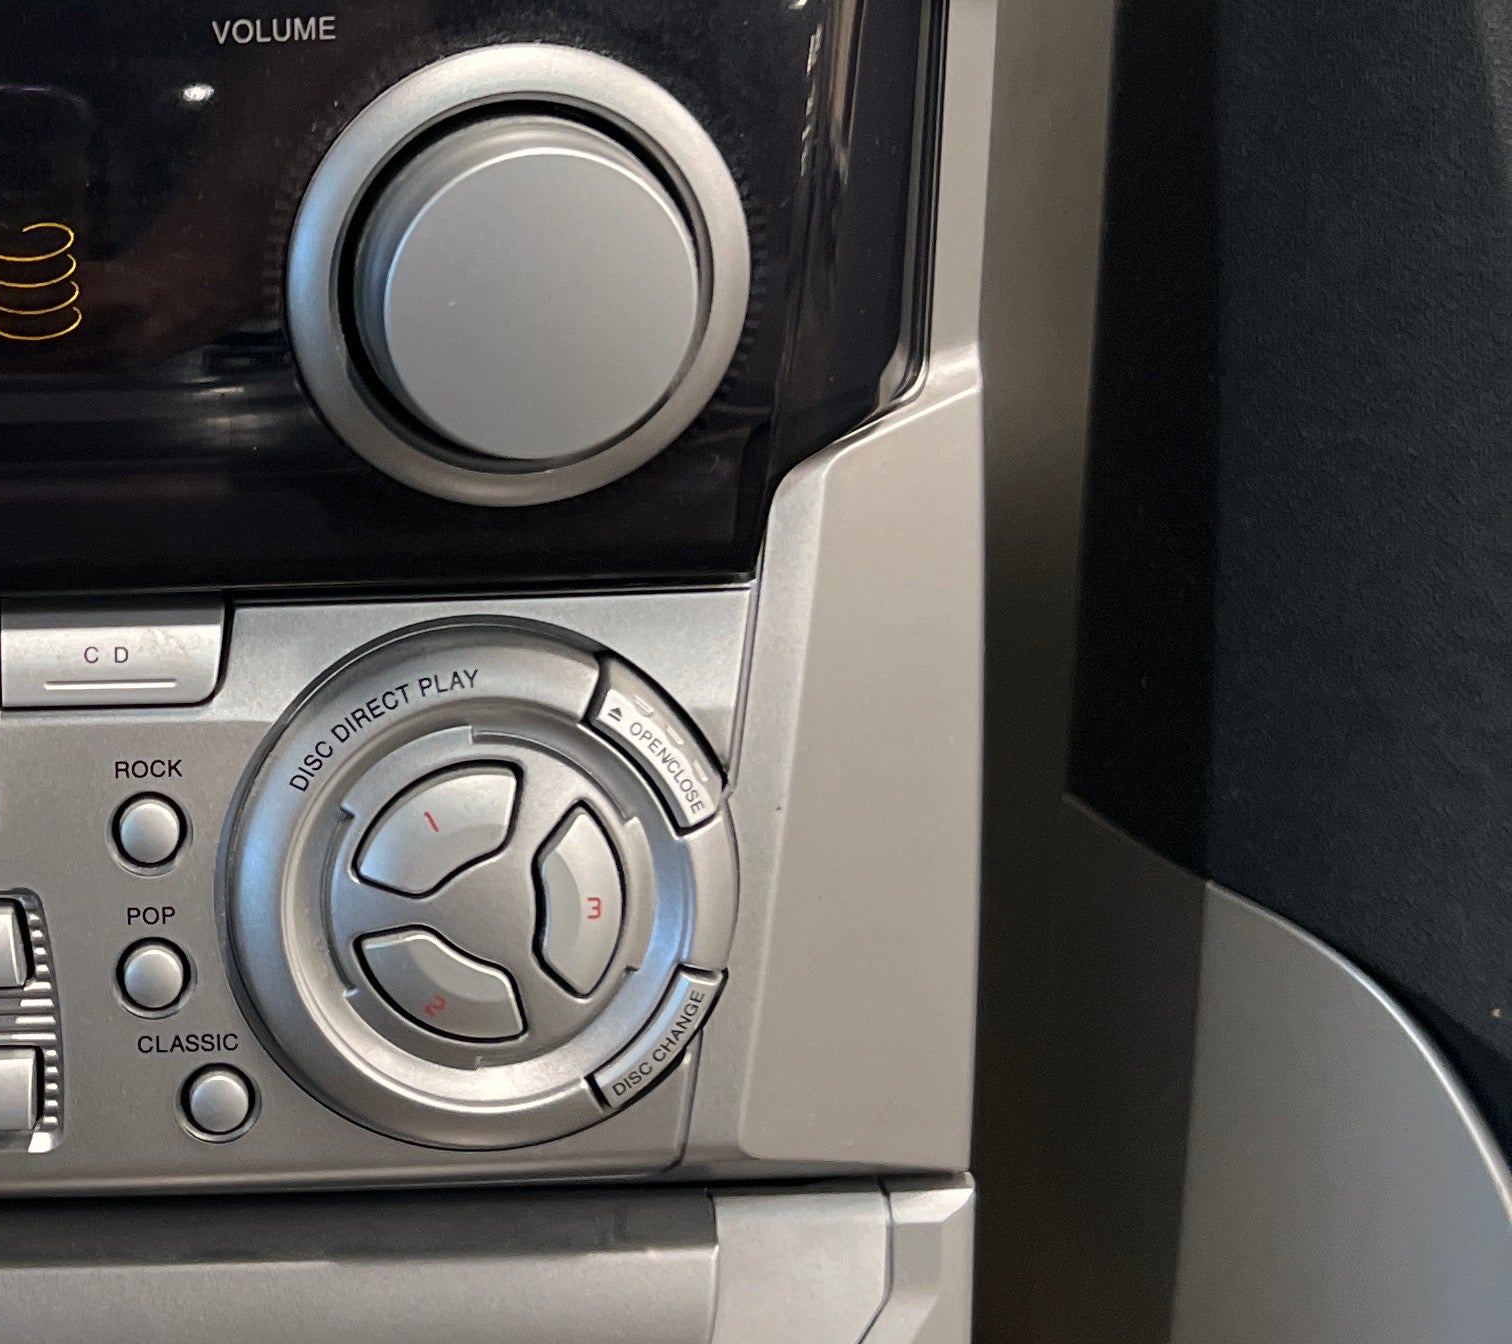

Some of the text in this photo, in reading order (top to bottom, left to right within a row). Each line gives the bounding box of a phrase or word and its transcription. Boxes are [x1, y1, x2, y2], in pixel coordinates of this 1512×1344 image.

[210, 15, 338, 47] VOLUME
[288, 668, 479, 793] DISC DIRECT PLAY
[114, 759, 184, 780] ROCK
[125, 905, 176, 927] POP
[586, 896, 602, 920] 3
[135, 1031, 240, 1054] CLASSIC
[611, 989, 706, 1097] DISC CHANGE
